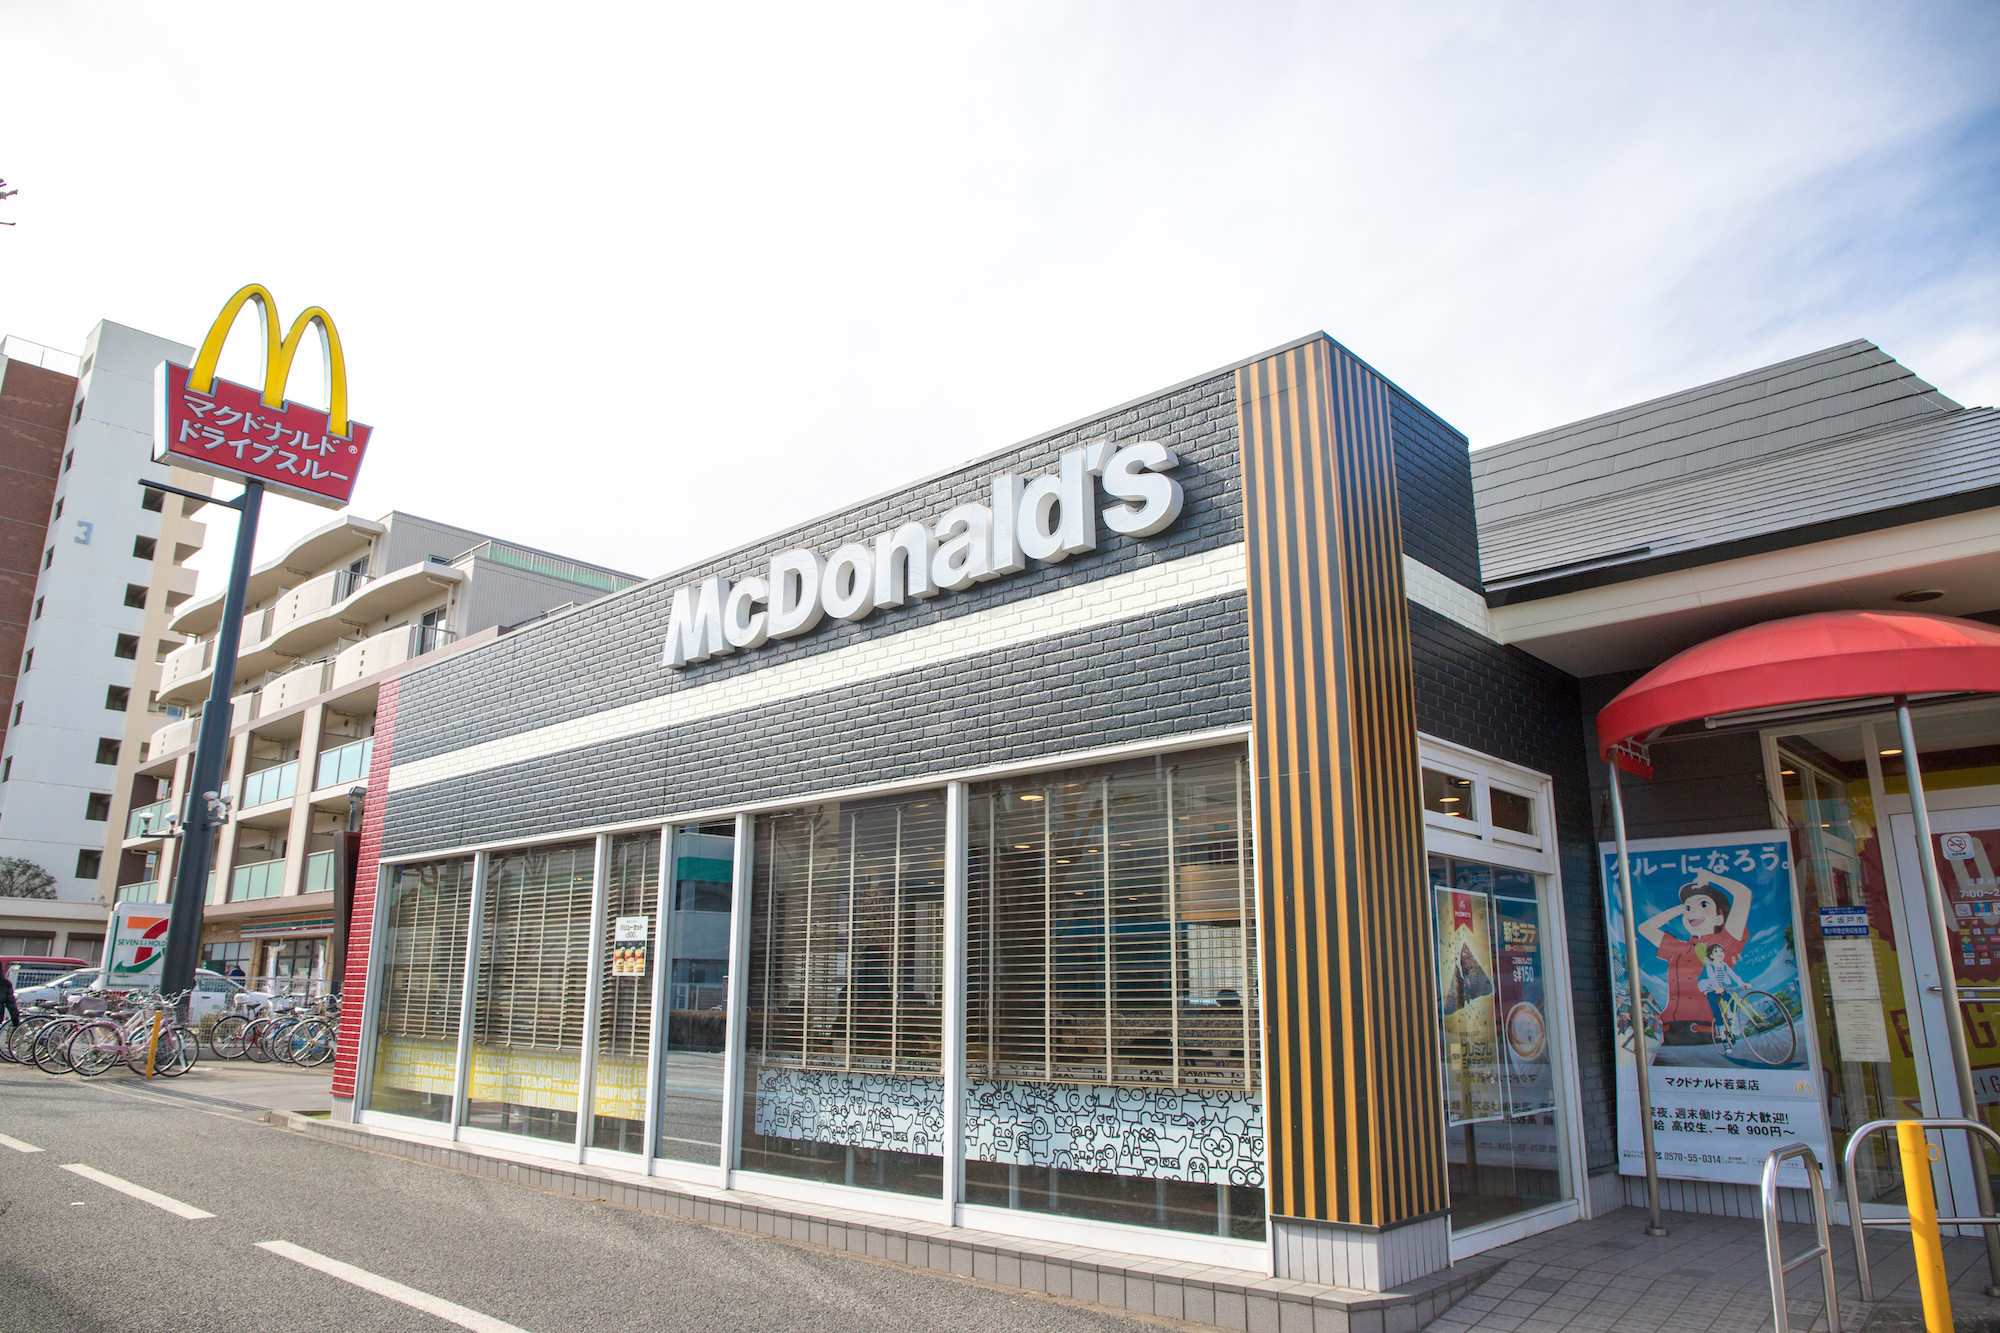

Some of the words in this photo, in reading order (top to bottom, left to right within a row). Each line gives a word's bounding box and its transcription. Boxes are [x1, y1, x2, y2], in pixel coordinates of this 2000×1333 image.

[183, 394, 341, 457] マクドナルド
[178, 418, 349, 482] ドライブスルー
[74, 520, 94, 545] 3
[661, 438, 1185, 670] McDonald's
[1836, 916, 1864, 924] 坂戸市
[1502, 920, 1537, 944] 新生ラテ
[409, 1063, 446, 1078] CHICAGO
[535, 1059, 553, 1076] USA
[563, 1061, 580, 1083] MOS
[604, 1066, 632, 1087] COFFEE
[506, 1074, 552, 1090] CHICAGO
[552, 1083, 579, 1093] TRADE
[1664, 1076, 1760, 1091] マクドナルド若葉店
[1664, 1151, 1722, 1165] 0570-55-0314
